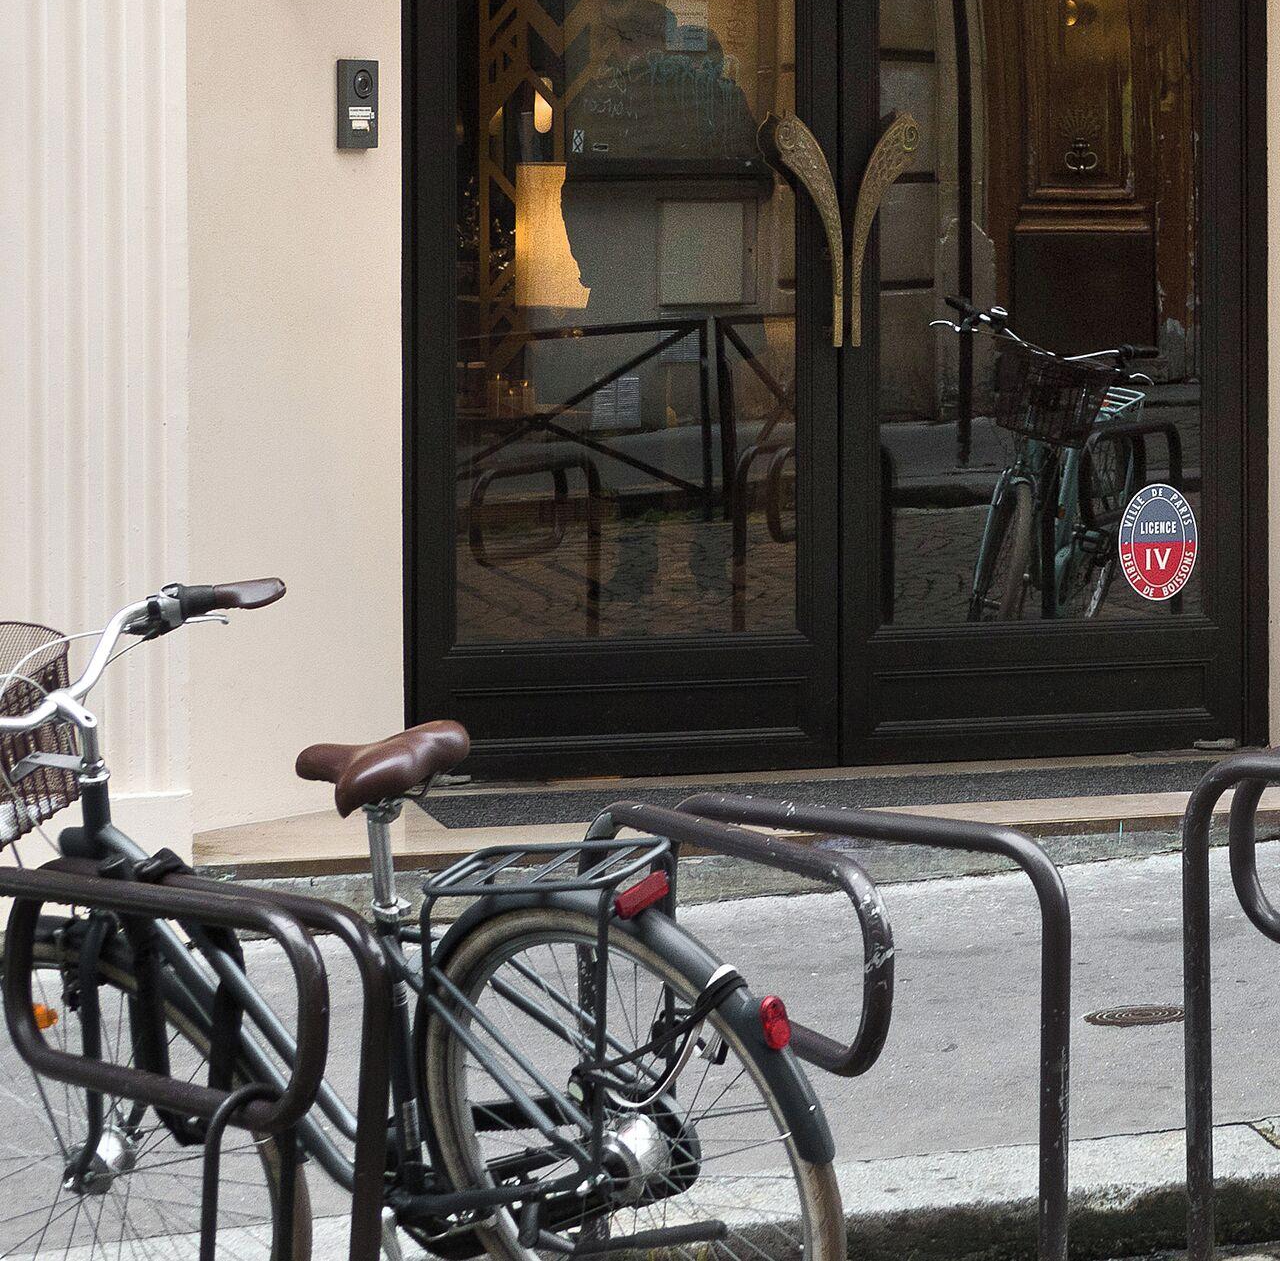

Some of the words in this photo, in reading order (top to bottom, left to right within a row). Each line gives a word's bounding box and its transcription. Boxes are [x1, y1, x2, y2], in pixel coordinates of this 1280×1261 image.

[1124, 496, 1145, 528] VILLE
[1152, 488, 1163, 497] DE
[1170, 494, 1192, 525] PARIS
[1140, 521, 1177, 534] LICENCE
[1122, 554, 1141, 583] DEBIT
[1142, 586, 1155, 596] DE
[1162, 552, 1194, 596] BOISSONS
[1145, 548, 1172, 570] IV
